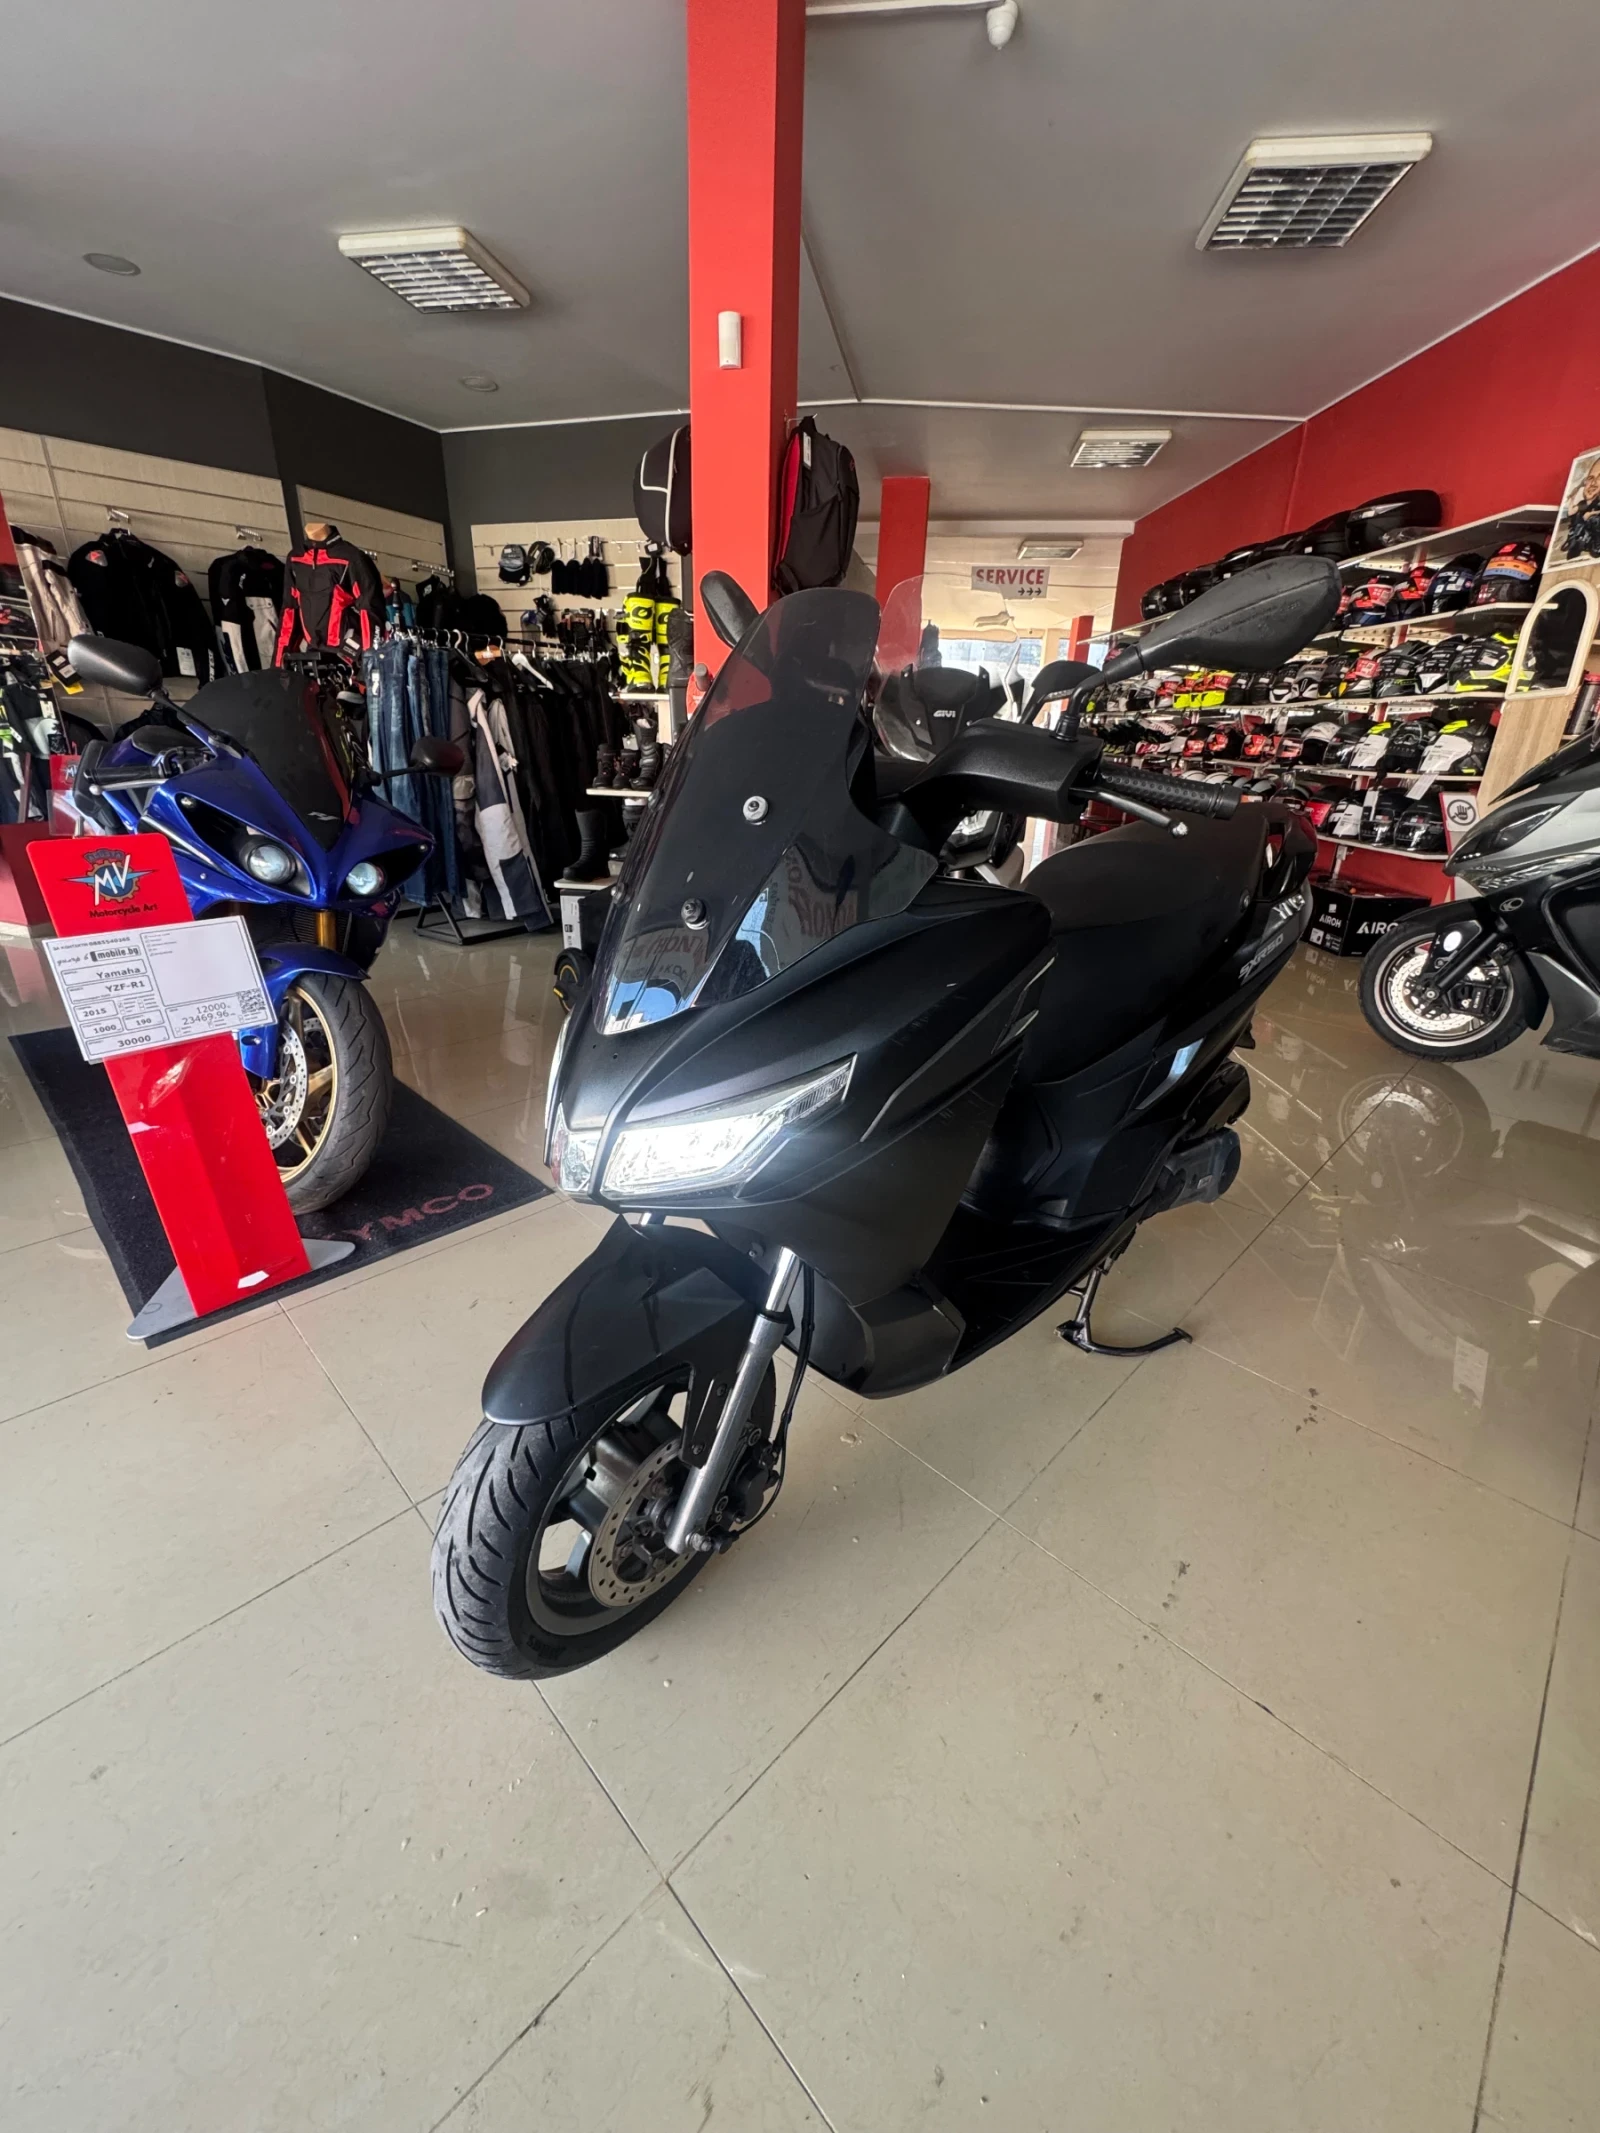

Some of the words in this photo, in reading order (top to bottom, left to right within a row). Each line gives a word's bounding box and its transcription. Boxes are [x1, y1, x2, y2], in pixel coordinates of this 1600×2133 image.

[976, 568, 1045, 585] SERVICE
[933, 709, 957, 718] GIVI
[95, 855, 131, 906] MV
[89, 905, 141, 918] Motorcycle
[143, 903, 158, 912] Art
[1319, 913, 1342, 928] AIROH
[97, 947, 139, 960] mobile.bg
[1238, 933, 1285, 980] SXR50
[96, 967, 141, 979] Yamaha
[105, 981, 145, 993] YZF-R1
[83, 1008, 107, 1017] 2015
[197, 1002, 226, 1014] 12000
[135, 1018, 152, 1026] 190
[182, 1010, 229, 1025] 23469.96
[93, 1025, 117, 1034] 1000
[118, 1035, 151, 1048] 30000
[324, 1183, 494, 1241] YMCO
